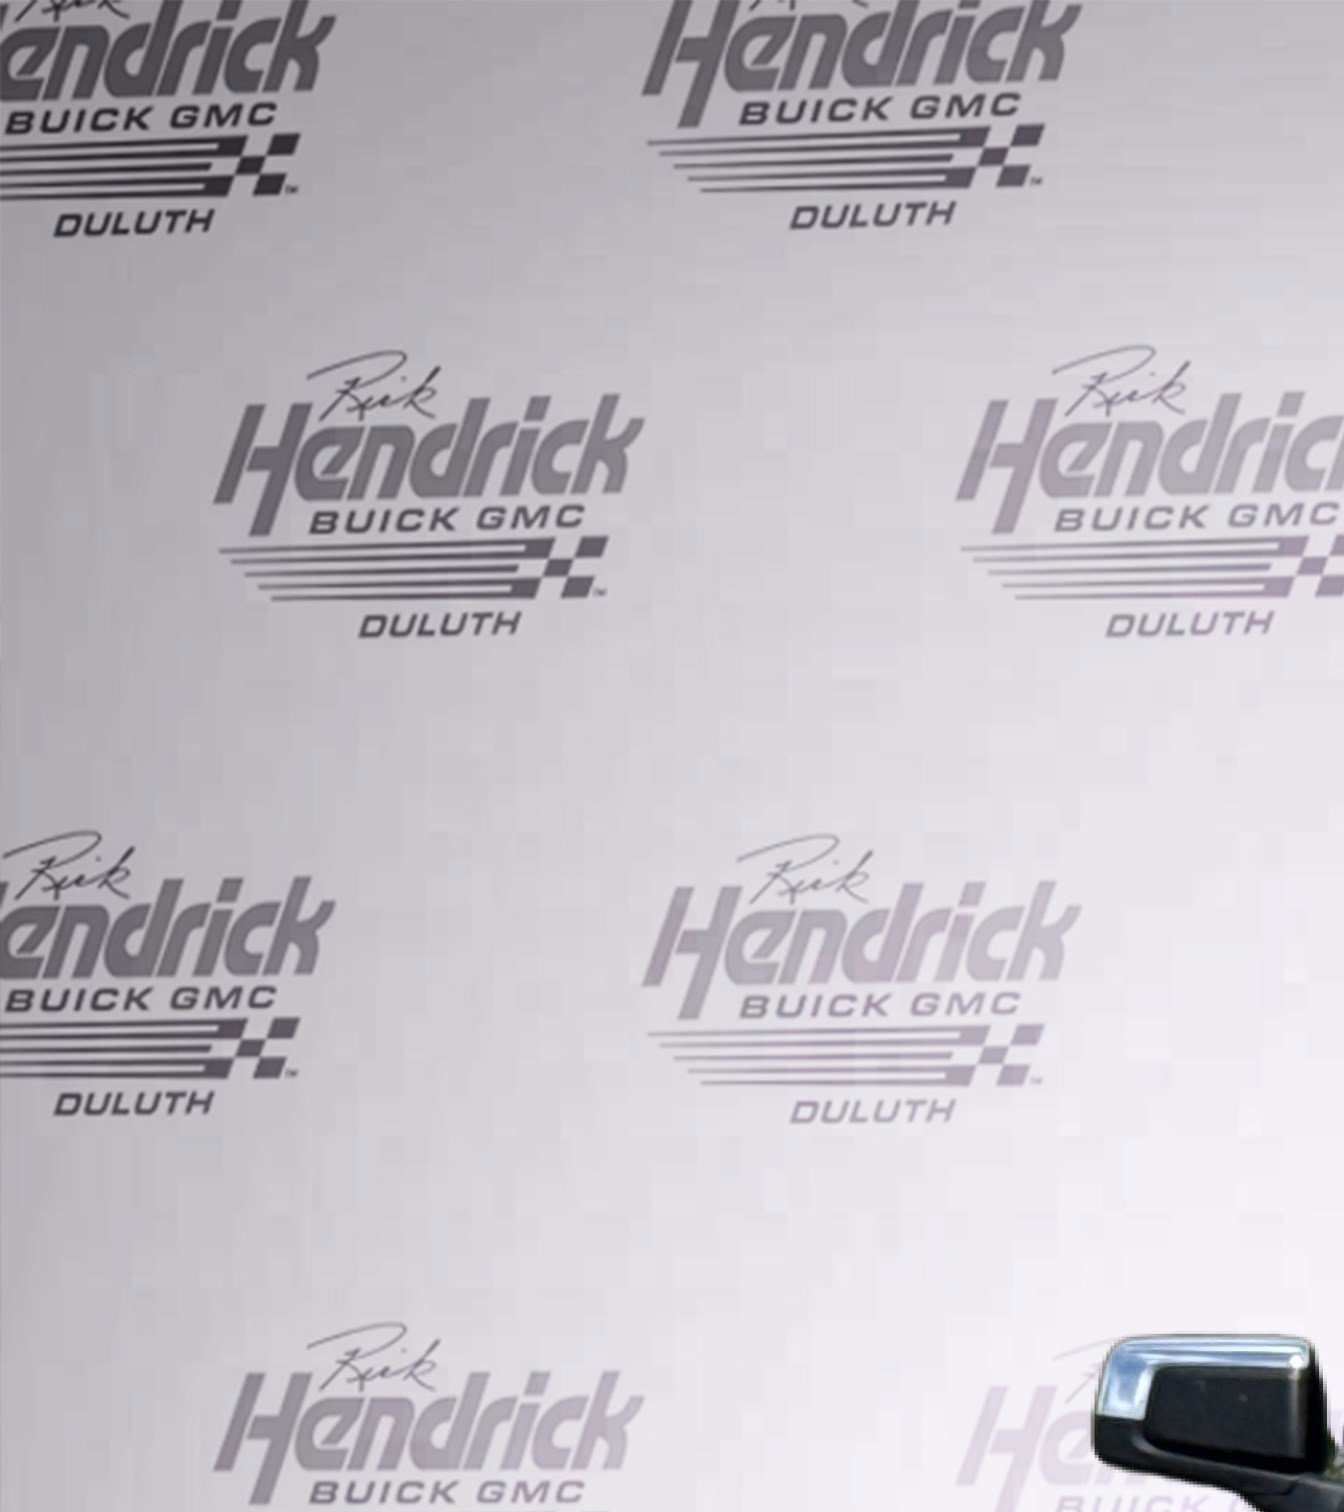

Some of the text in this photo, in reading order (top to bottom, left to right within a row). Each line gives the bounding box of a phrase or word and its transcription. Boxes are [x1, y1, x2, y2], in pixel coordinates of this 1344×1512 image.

[0, 0, 336, 101] endrick
[641, 0, 1082, 128] Hendrick
[5, 102, 277, 135] BUICK GMC
[739, 92, 1022, 126] BUICK GMC
[54, 208, 214, 237] DULUTH
[789, 201, 957, 230] DULUTH
[213, 394, 646, 537] Hendrick
[308, 504, 586, 536] BUICK GMC
[1053, 501, 1343, 534] BUICK GMC
[358, 611, 522, 639] DULUTH
[1105, 609, 1275, 638] DULUTH
[0, 876, 337, 980] endrick
[641, 880, 1083, 1020] Hendrick
[5, 985, 278, 1013] BUICK GMC
[738, 991, 1021, 1020] BUICK GMC
[53, 1090, 215, 1117] DULUTH
[788, 1097, 957, 1125] DULUTH
[213, 1370, 645, 1506] Hendrick
[308, 1480, 586, 1505] BUICK GMC
